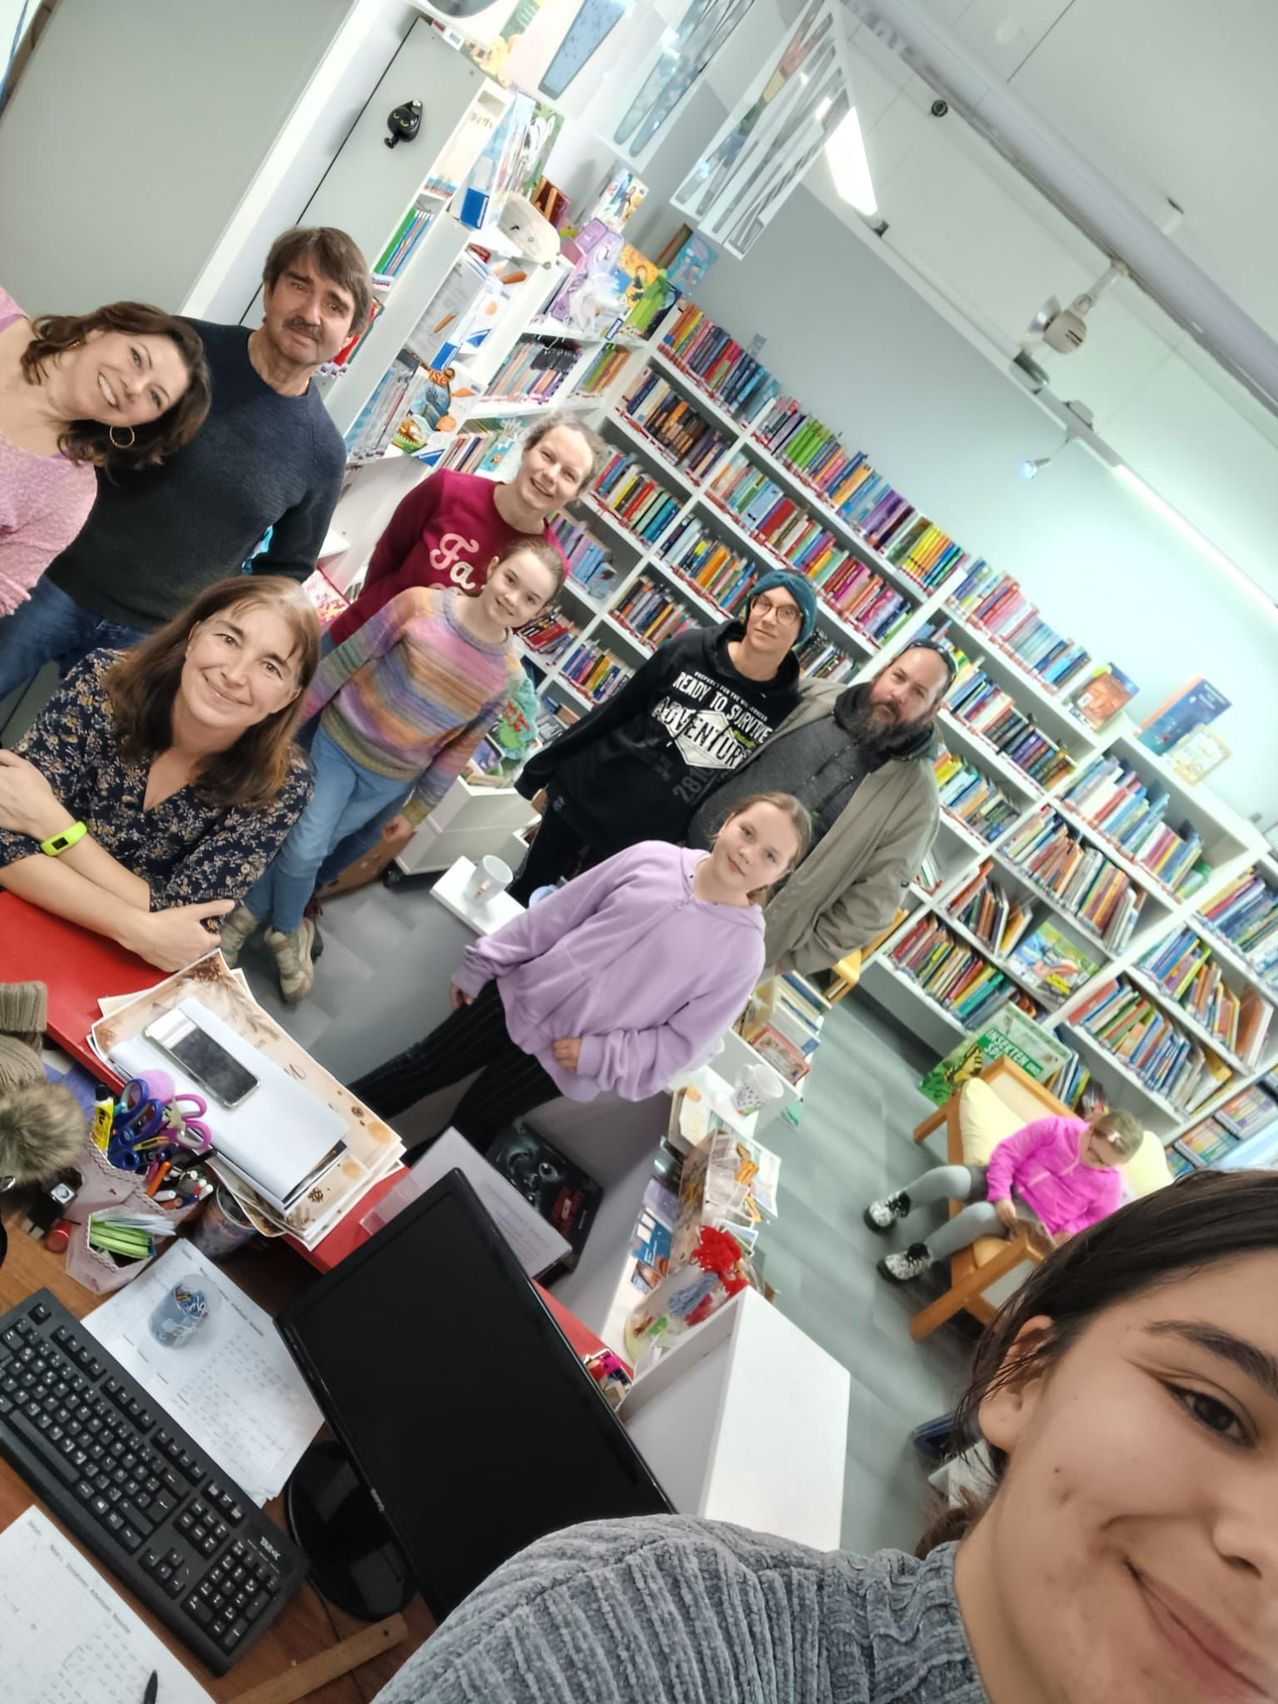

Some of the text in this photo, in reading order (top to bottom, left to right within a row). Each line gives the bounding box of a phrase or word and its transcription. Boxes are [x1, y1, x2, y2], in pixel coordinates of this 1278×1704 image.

[428, 535, 485, 588] Fa
[672, 672, 708, 702] READY
[709, 691, 728, 712] TO
[726, 704, 773, 743] SURVIVE
[719, 684, 730, 695] FOR
[728, 691, 740, 702] THE
[738, 698, 768, 722] WILERNESS
[983, 1043, 1002, 1058] SPI
[984, 1029, 1029, 1066] INSEKTEN
